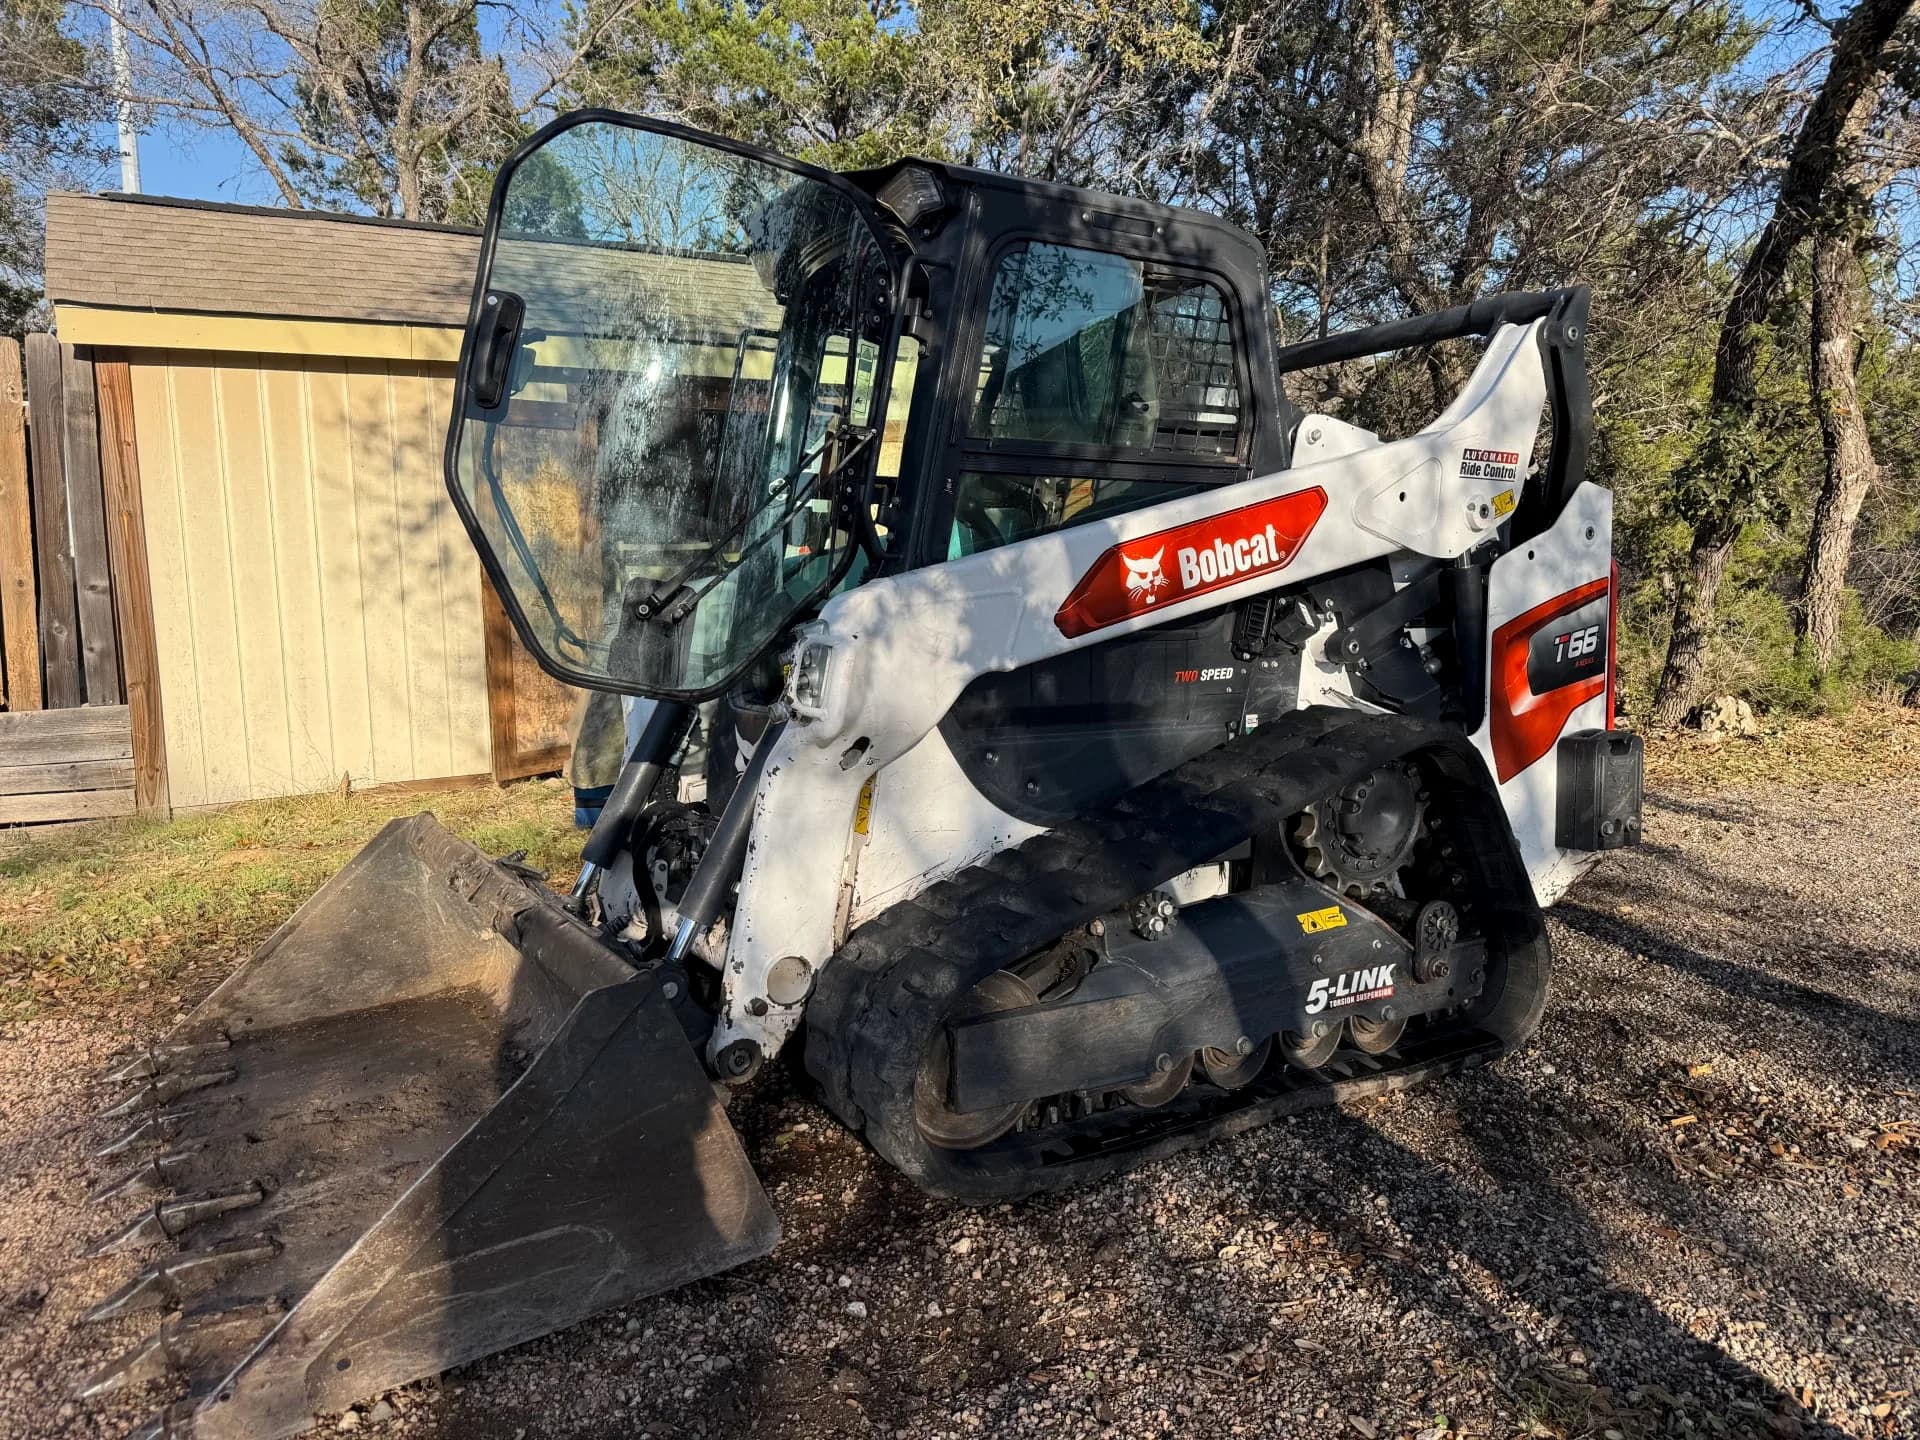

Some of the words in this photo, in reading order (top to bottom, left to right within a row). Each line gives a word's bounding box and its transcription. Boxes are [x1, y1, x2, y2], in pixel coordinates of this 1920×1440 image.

[1464, 450, 1518, 464] AUTOMATIC
[1460, 462, 1481, 476] Ride
[1484, 464, 1516, 479] Control
[1177, 524, 1280, 590] Bobcat
[1554, 625, 1600, 663] T66
[1175, 670, 1199, 682] TWO
[1200, 667, 1234, 681] SPEED
[1305, 963, 1397, 1015] 5-LINK
[1329, 996, 1355, 1009] TORSION
